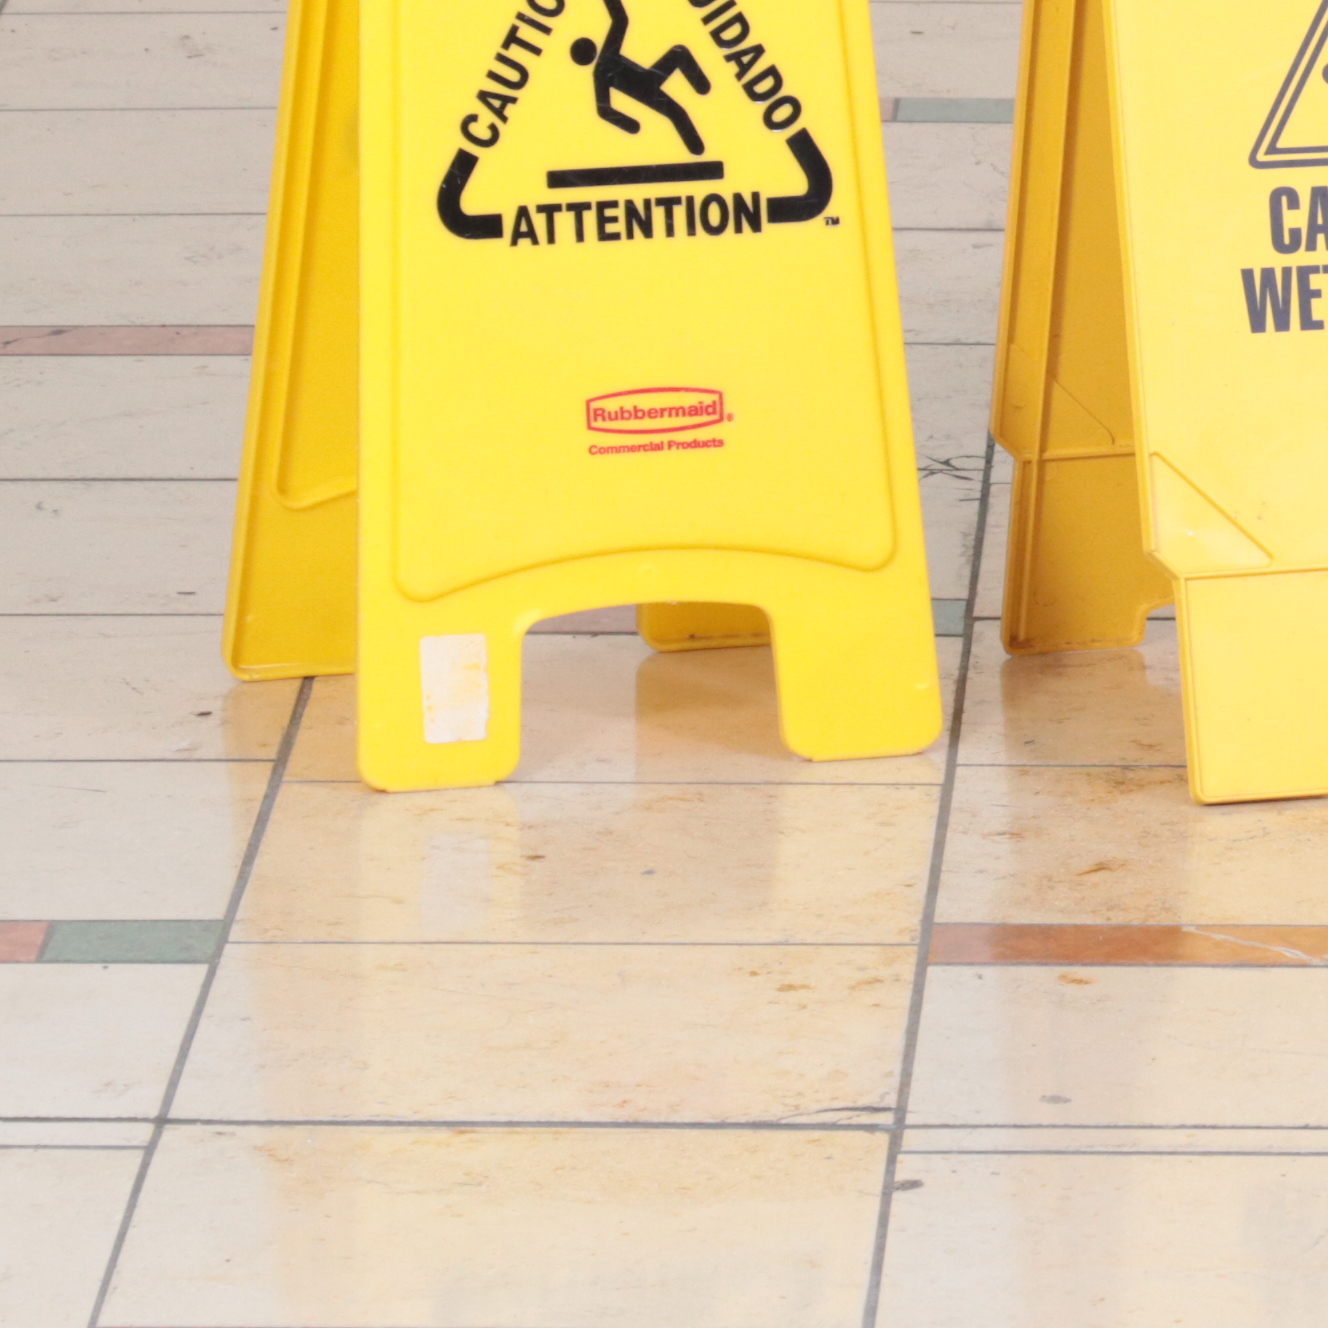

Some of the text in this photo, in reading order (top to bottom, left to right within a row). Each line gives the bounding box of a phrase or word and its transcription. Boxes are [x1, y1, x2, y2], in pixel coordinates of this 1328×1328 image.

[510, 191, 762, 247] ATTENTION
[592, 400, 718, 422] Rubbermaid
[588, 438, 725, 456] Commercial Products
